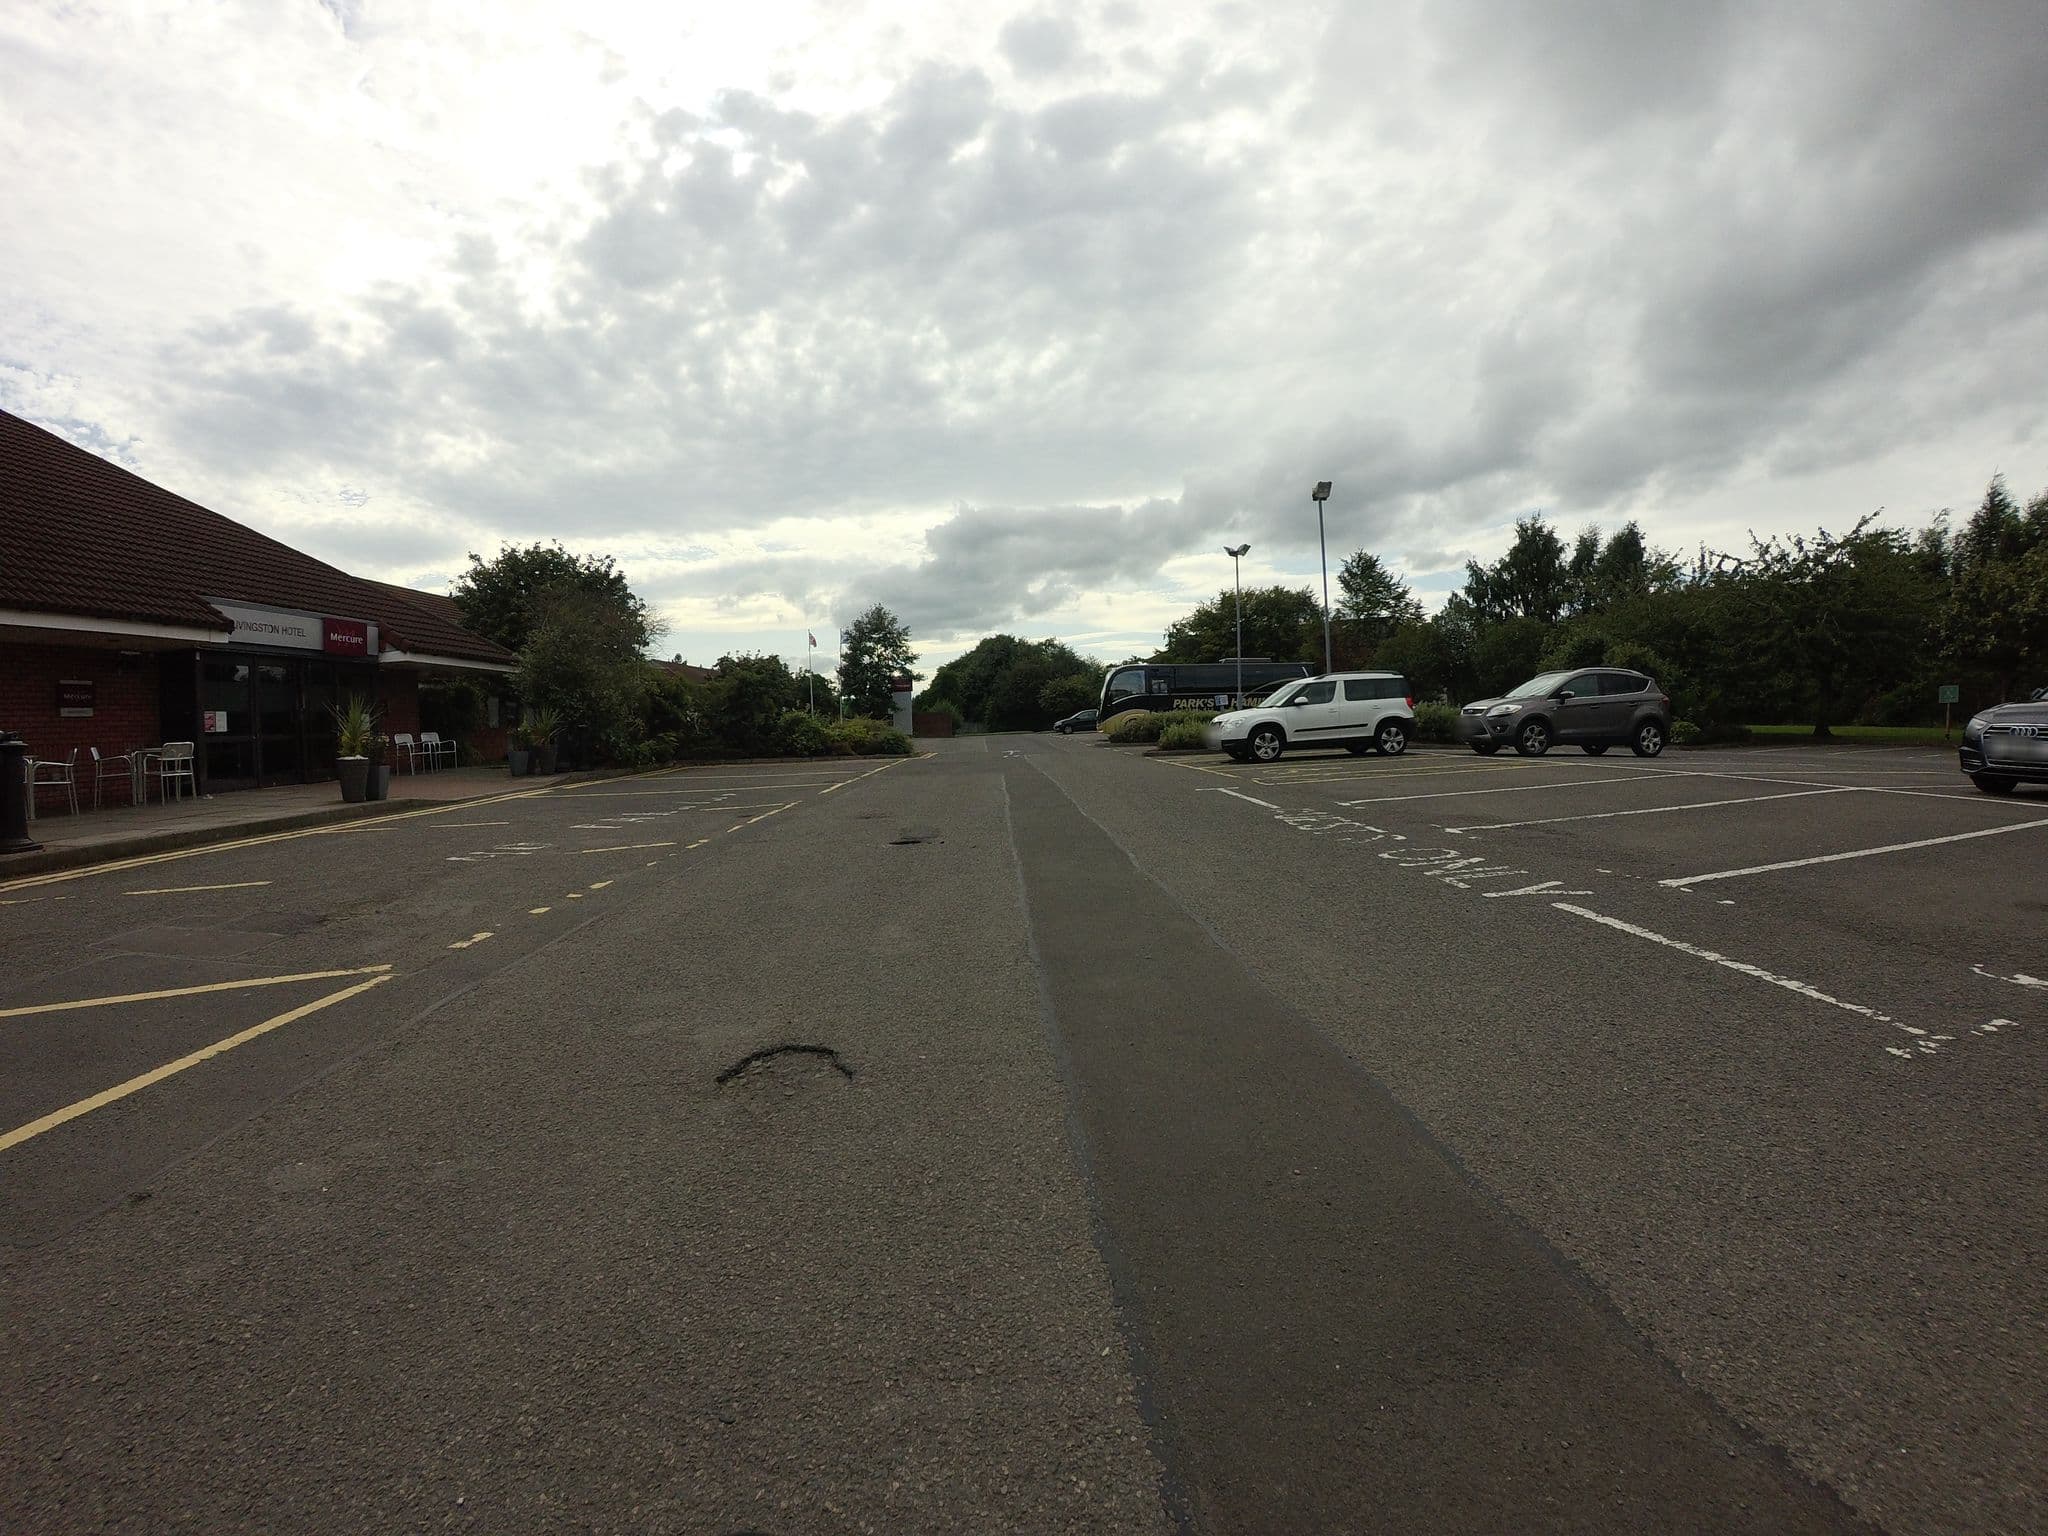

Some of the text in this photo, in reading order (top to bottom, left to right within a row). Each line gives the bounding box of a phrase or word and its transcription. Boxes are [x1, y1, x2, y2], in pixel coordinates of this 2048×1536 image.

[235, 621, 306, 638] IVINGSTON HOTEL
[330, 632, 364, 645] Mercure
[1173, 698, 1215, 708] PARK'S
[1378, 848, 1594, 898] ONLY
